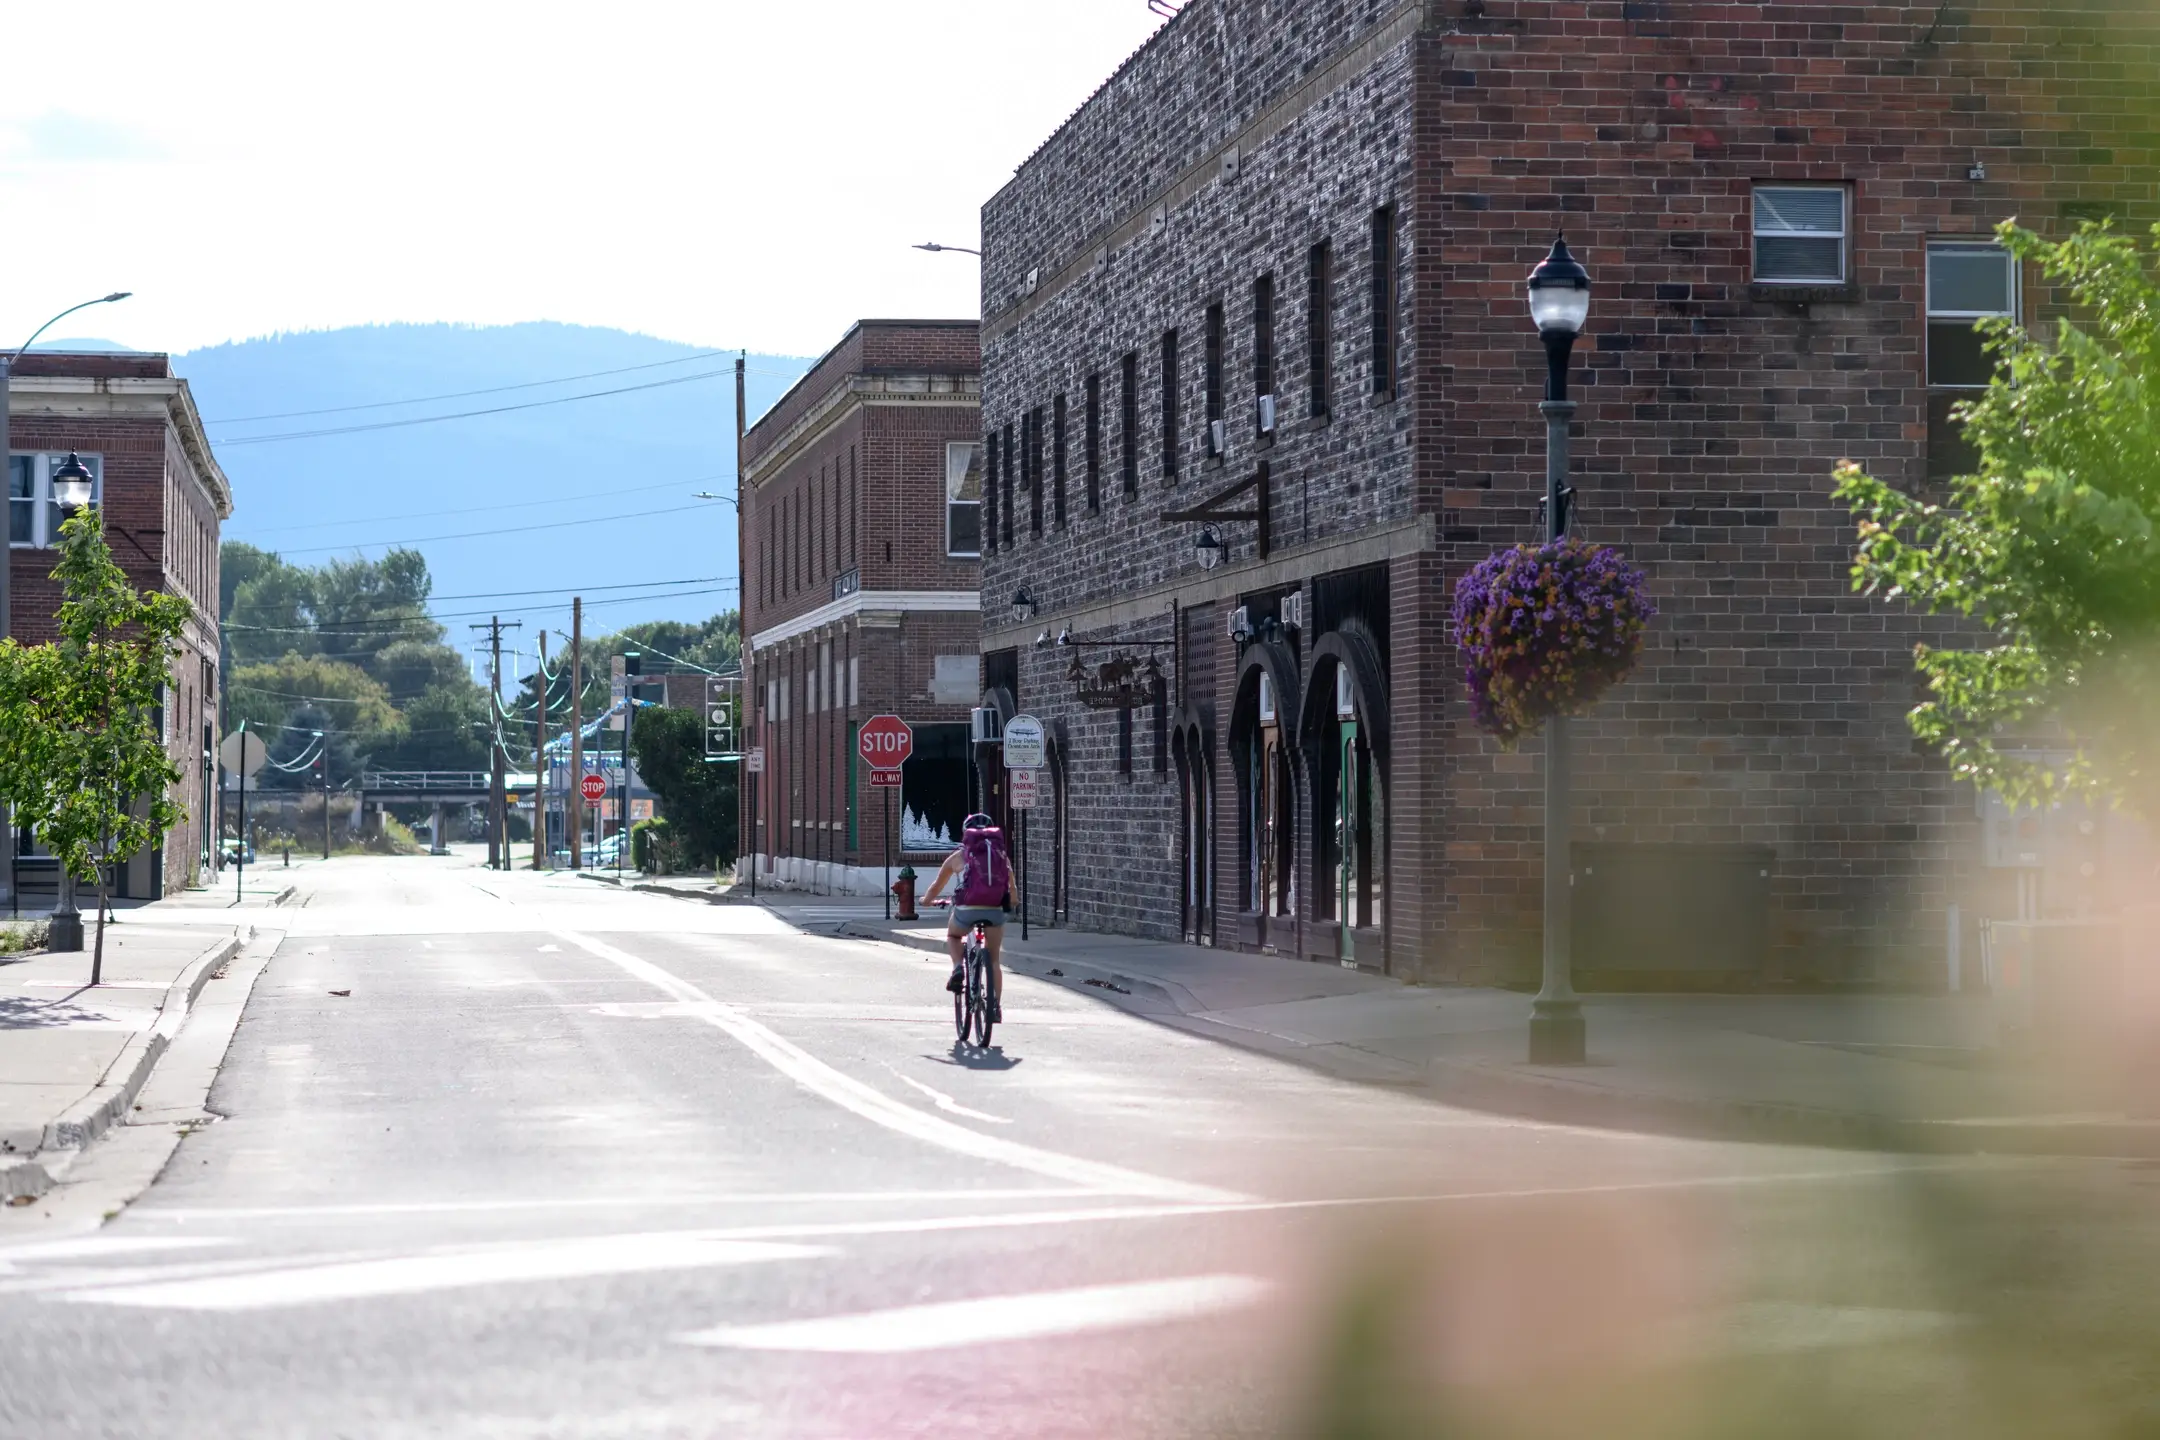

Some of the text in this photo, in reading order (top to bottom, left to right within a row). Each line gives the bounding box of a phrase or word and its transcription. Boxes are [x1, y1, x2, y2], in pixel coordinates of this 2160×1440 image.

[863, 732, 909, 752] STOP
[1019, 772, 1029, 781] NO
[582, 782, 605, 793] STOP
[1013, 782, 1036, 791] PARKING
